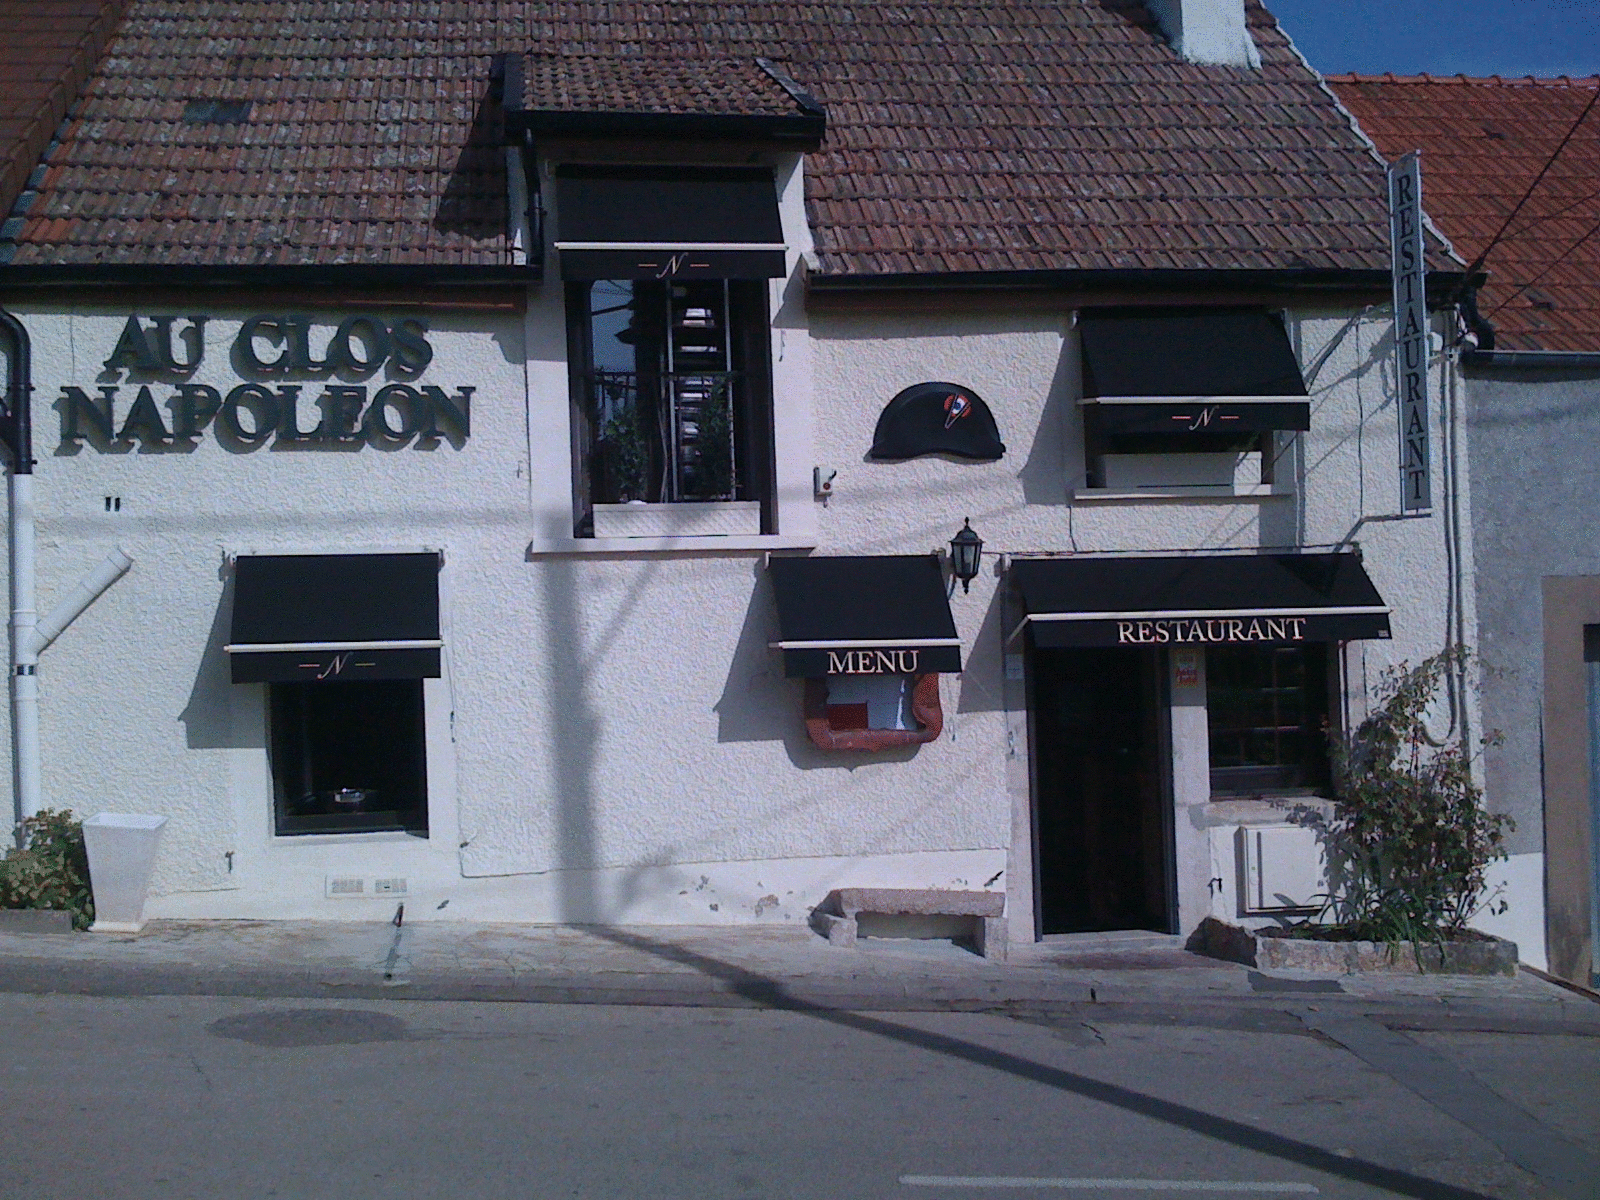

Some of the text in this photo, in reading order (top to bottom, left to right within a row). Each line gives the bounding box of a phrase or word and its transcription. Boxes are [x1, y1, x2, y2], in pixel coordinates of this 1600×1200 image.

[655, 251, 689, 279] N
[103, 313, 433, 370] AU CLOS
[1396, 173, 1426, 501] RESTAURANT
[59, 383, 477, 440] NAPOLEON
[1188, 404, 1220, 431] N
[1116, 617, 1307, 645] RESTAURANT
[316, 651, 354, 680] N
[826, 649, 921, 675] MENU
